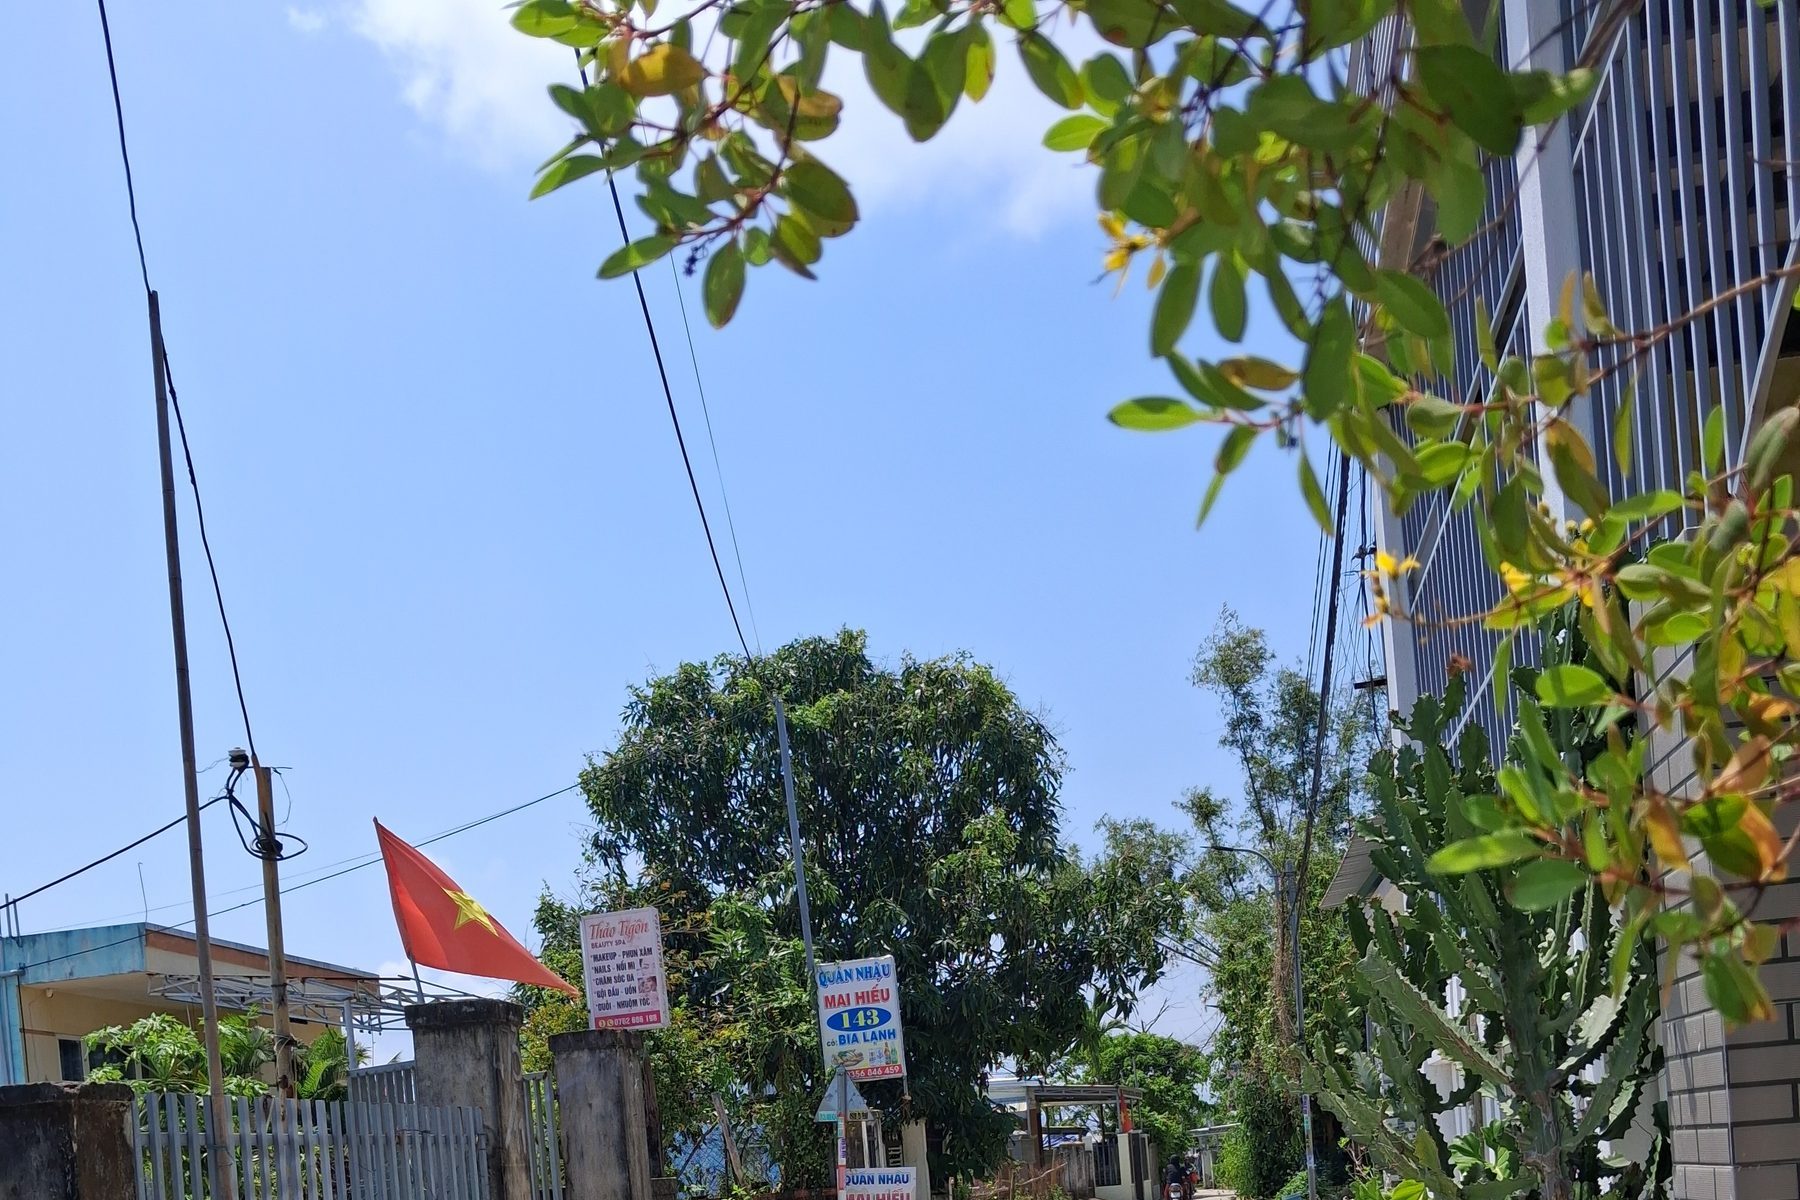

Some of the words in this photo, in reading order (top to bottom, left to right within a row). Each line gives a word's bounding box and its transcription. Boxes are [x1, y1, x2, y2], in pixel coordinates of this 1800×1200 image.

[591, 941, 613, 950] BEAUTY
[818, 966, 853, 988] QUÁN
[856, 962, 891, 982] NHẬU
[824, 993, 851, 1009] MAI
[855, 984, 890, 1006] HIẾU
[841, 1008, 880, 1029] 143
[838, 1033, 860, 1046] BIA
[863, 1028, 896, 1045] LẠNH
[884, 1065, 900, 1074] 459
